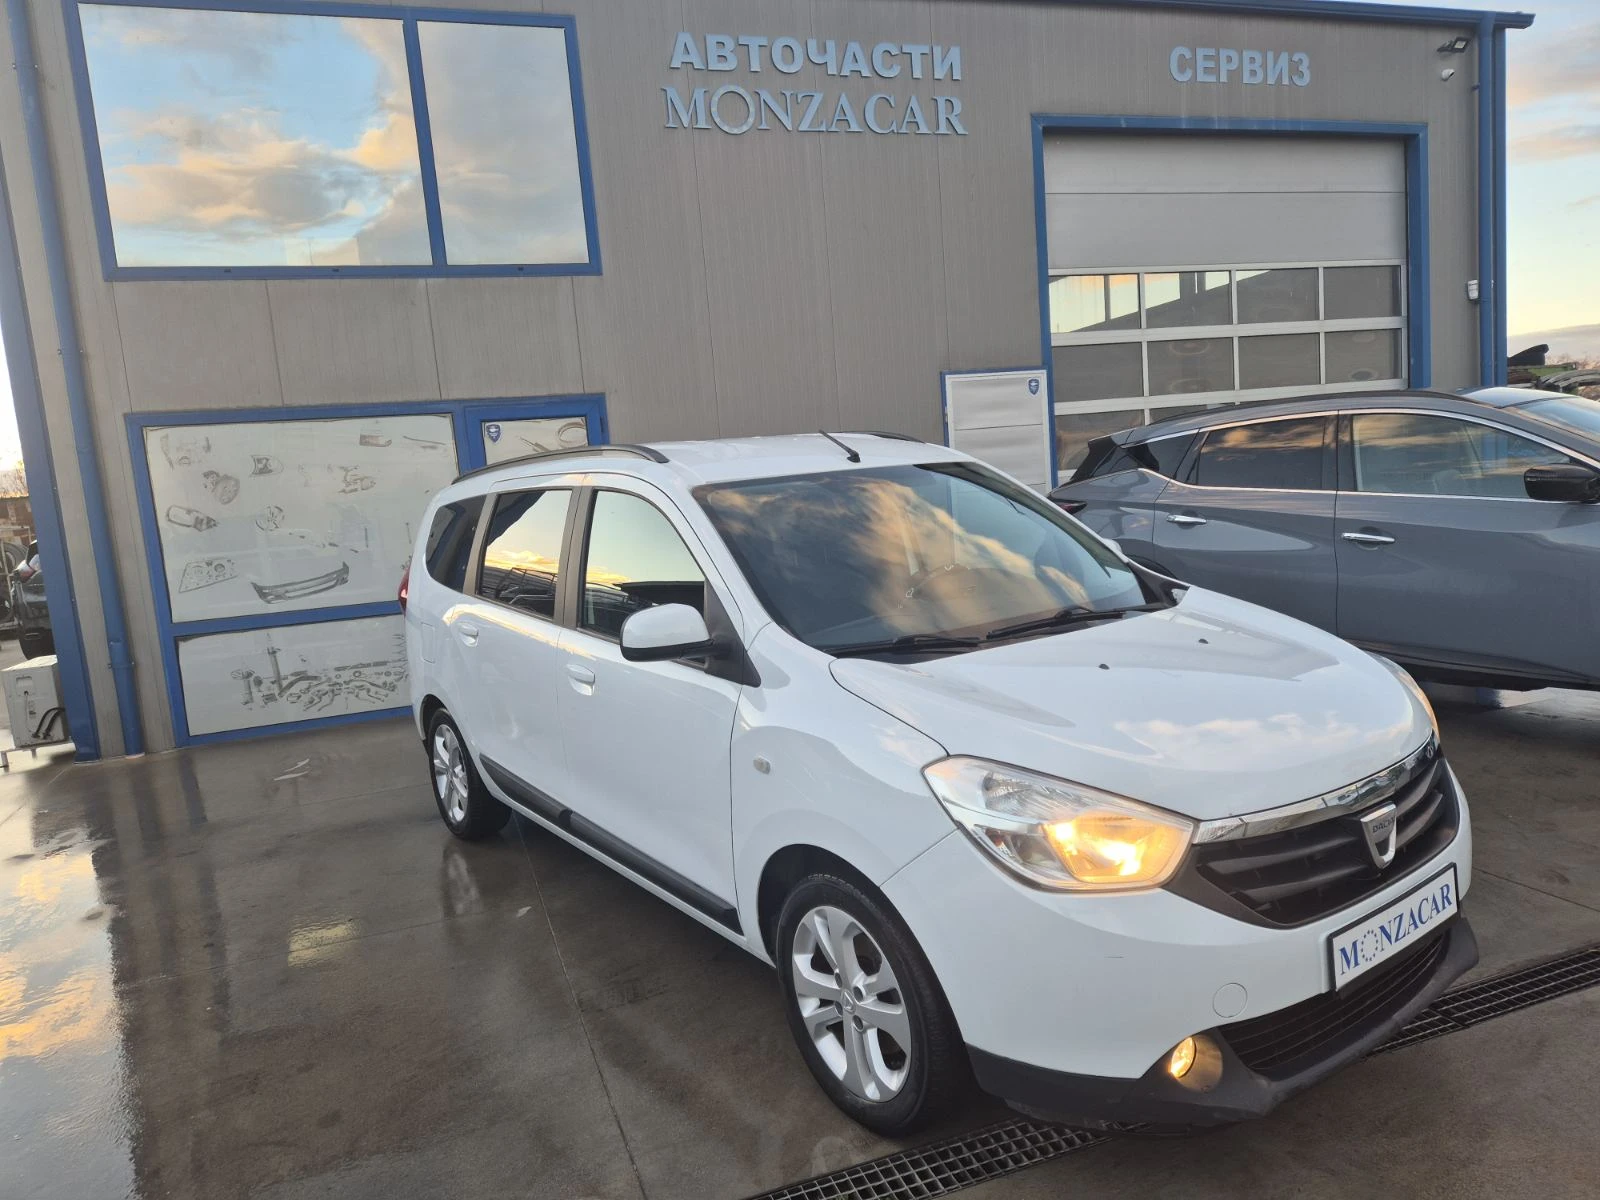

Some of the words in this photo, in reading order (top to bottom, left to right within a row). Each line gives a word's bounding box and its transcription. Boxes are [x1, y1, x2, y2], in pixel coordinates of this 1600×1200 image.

[669, 31, 961, 81] АВТОЧАСТИ
[1169, 46, 1311, 87] СЕРВИЗ
[660, 85, 968, 135] MONZACAR
[1339, 883, 1453, 975] MONZACAR
